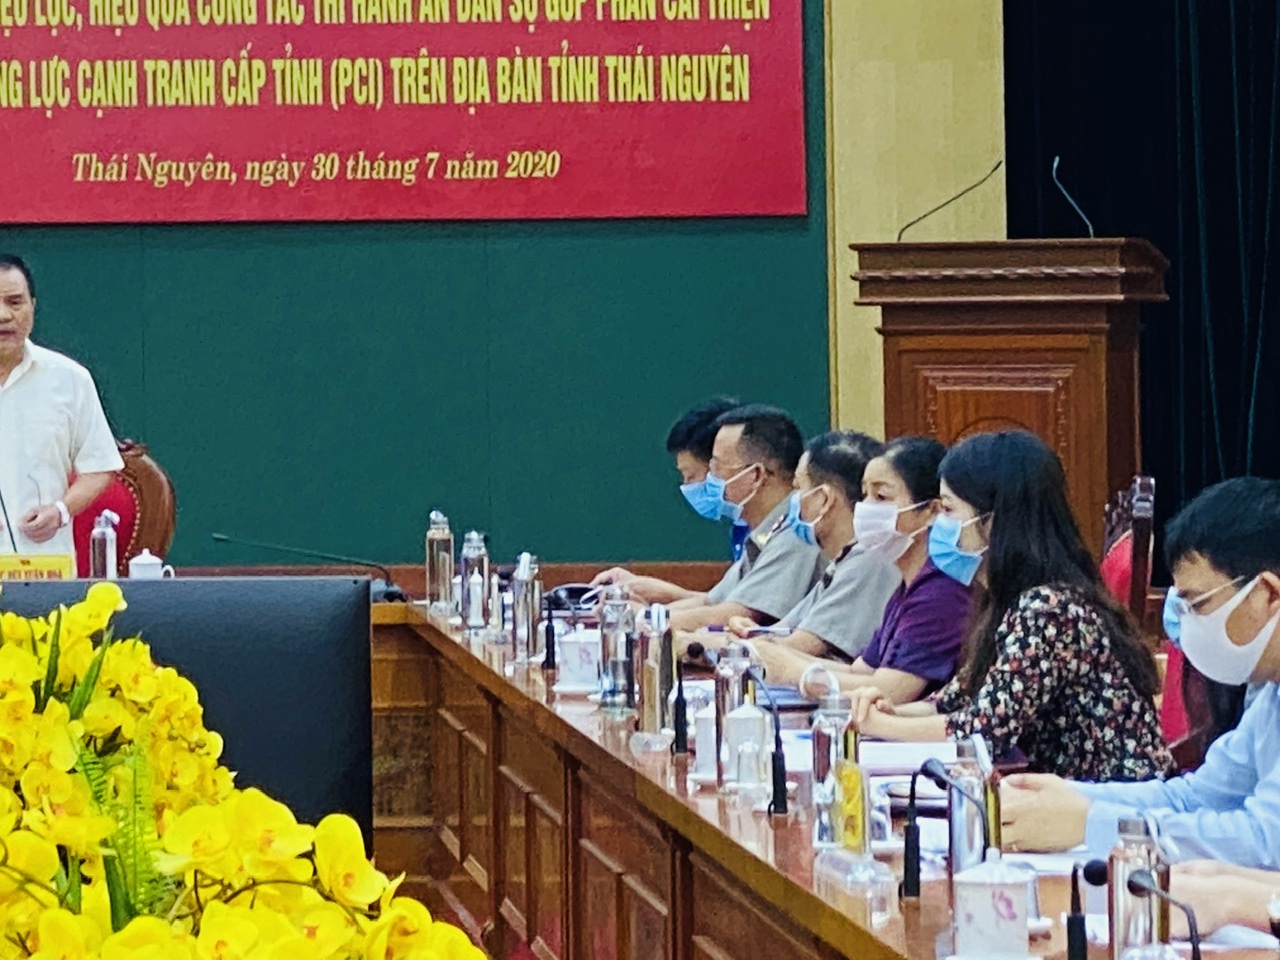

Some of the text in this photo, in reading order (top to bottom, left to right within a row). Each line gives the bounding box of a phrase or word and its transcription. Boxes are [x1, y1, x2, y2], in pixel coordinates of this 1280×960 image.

[29, 55, 71, 118] LỰC
[77, 59, 138, 118] CẠNH
[143, 58, 216, 106] TRANH
[221, 42, 267, 106] CẤP
[271, 43, 323, 106] TỈNH
[330, 57, 384, 110] (PCI)
[389, 47, 447, 105] TRÊN
[452, 56, 491, 114] ĐỊA
[496, 46, 543, 104] BÀN
[547, 40, 600, 103] TỈNH
[604, 44, 655, 103] THÁI
[660, 44, 750, 102] NGUYÊN
[72, 150, 561, 188] Thái Nguyên, ngày 30 tháng 7 năm 2020
